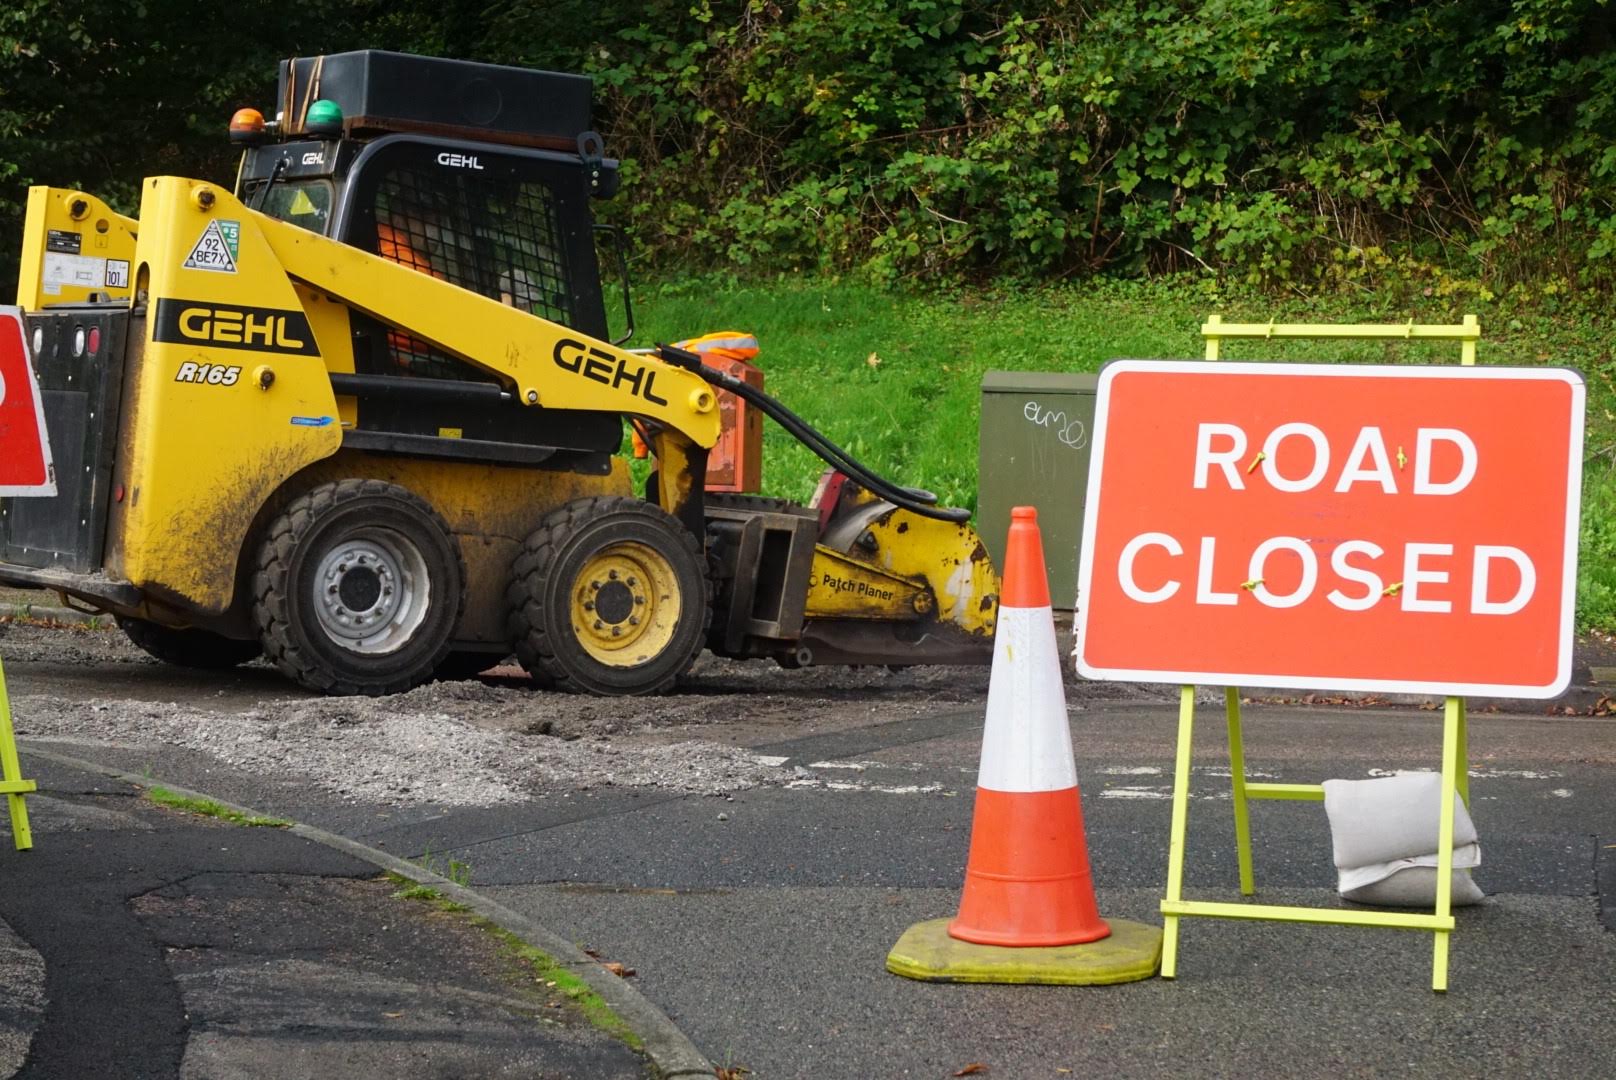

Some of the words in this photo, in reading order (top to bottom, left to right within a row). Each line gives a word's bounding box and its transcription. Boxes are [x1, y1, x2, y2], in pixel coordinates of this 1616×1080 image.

[302, 153, 324, 165] GEHL
[437, 153, 484, 170] GEHL
[196, 250, 225, 264] BE7X
[205, 238, 219, 251] 92
[108, 271, 120, 286] 101
[178, 307, 304, 349] GEHL
[175, 361, 242, 386] R165
[553, 338, 668, 407] GEHL
[1193, 422, 1478, 496] ROAD
[1117, 532, 1537, 616] CLOSED
[823, 574, 855, 592] Patch
[857, 582, 894, 601] Planer
